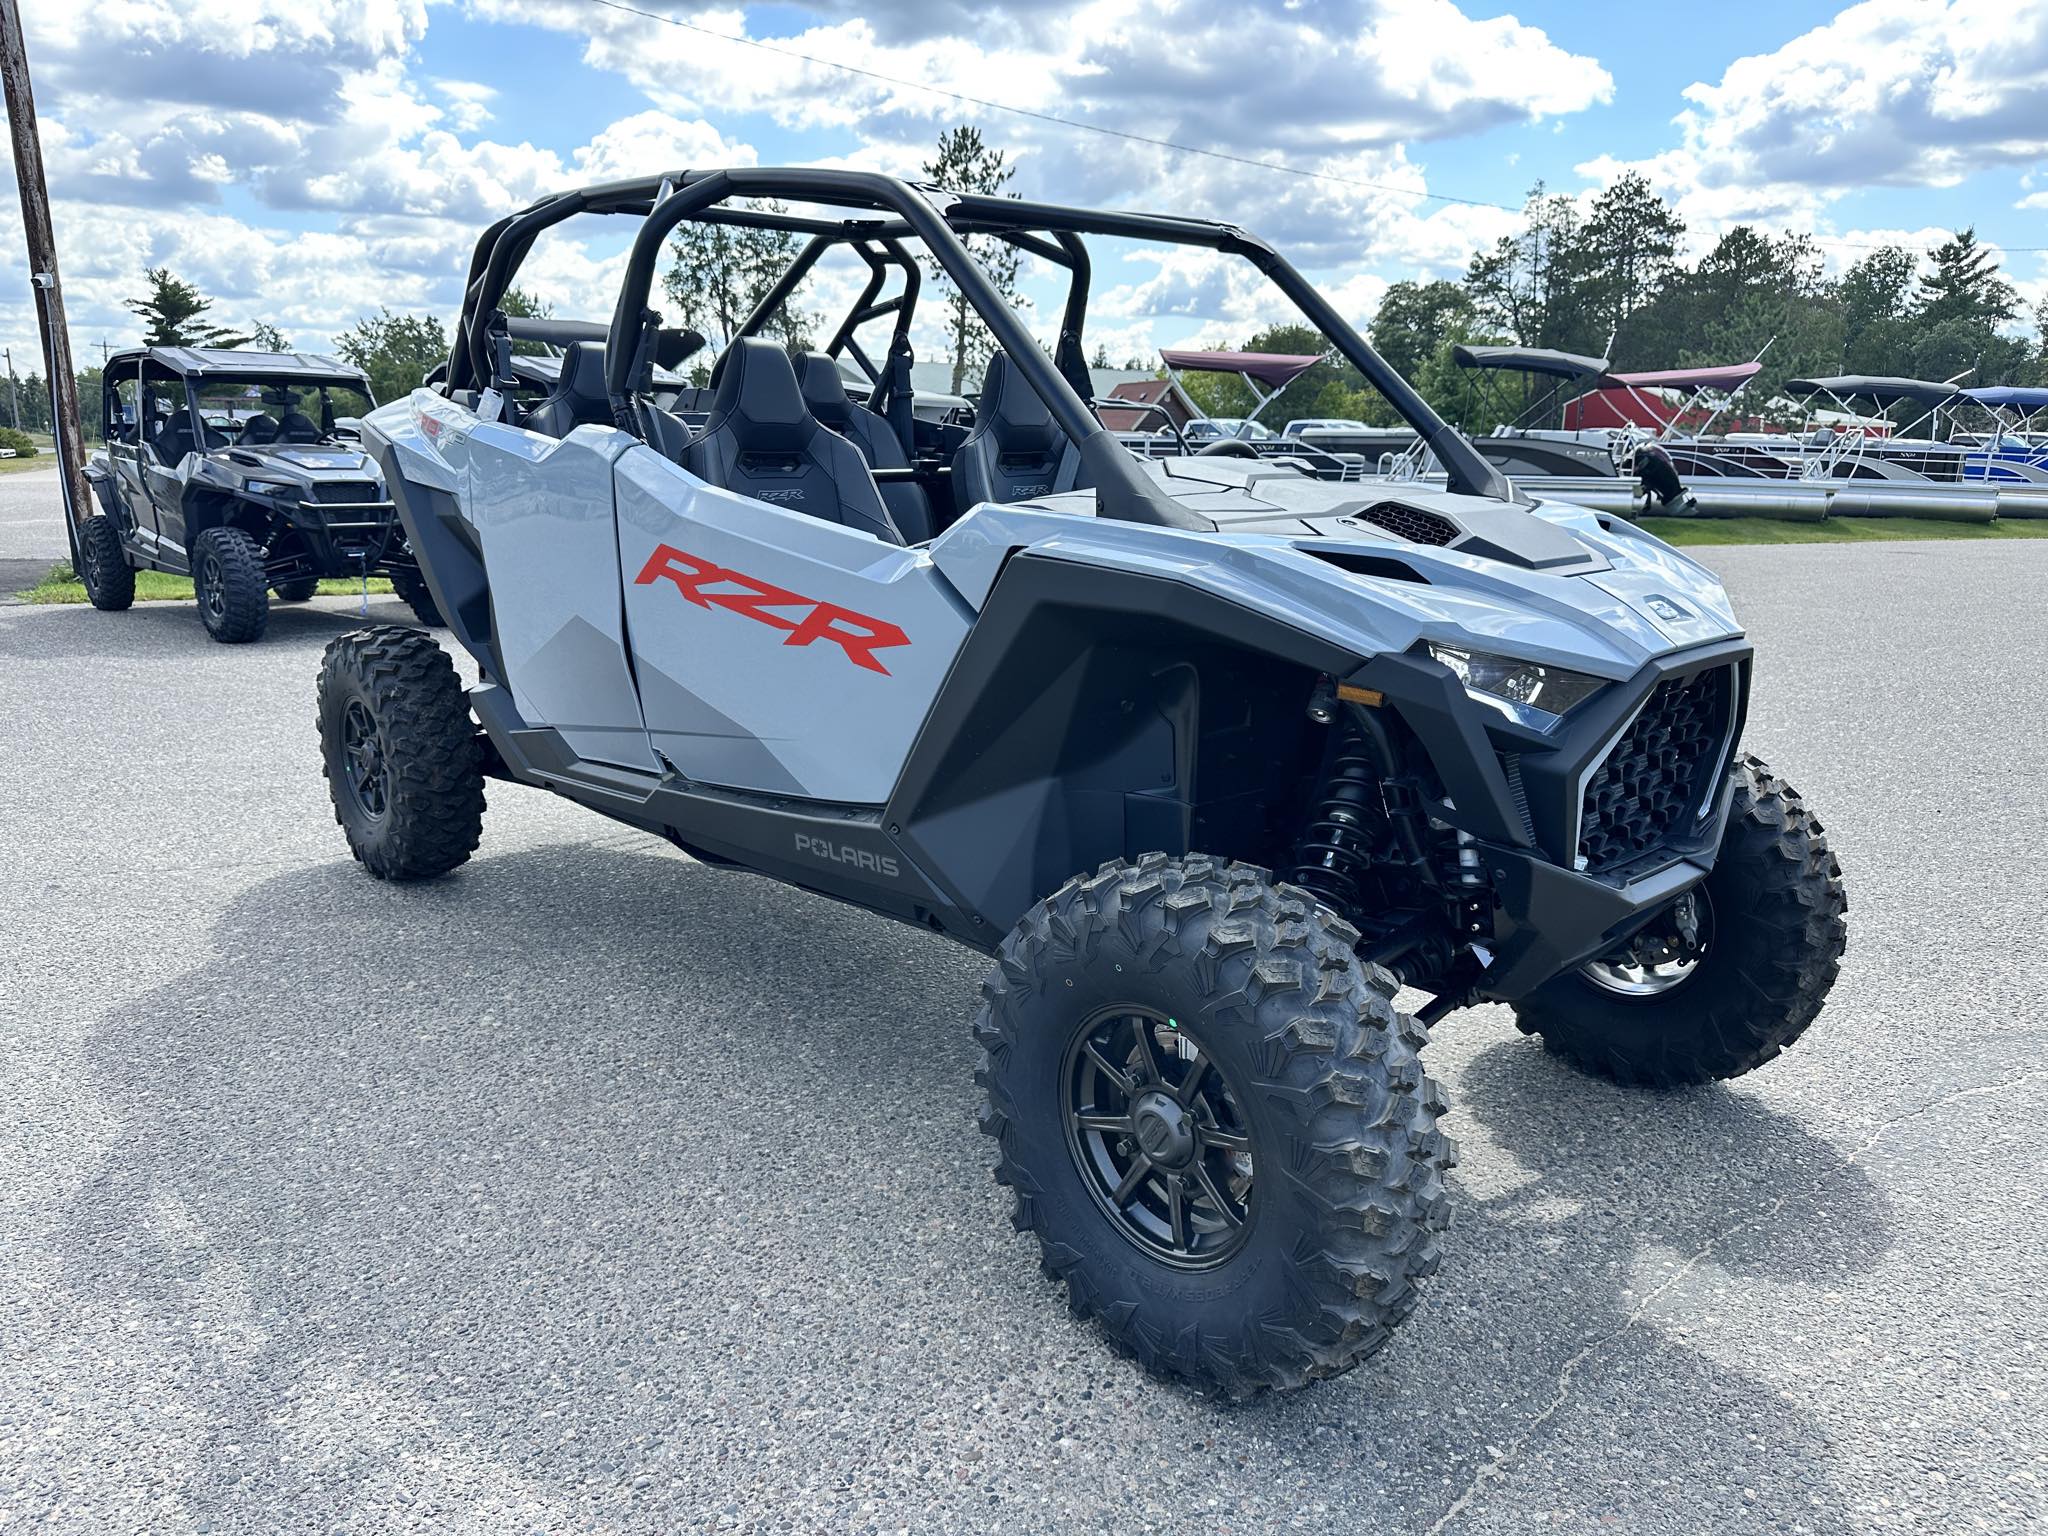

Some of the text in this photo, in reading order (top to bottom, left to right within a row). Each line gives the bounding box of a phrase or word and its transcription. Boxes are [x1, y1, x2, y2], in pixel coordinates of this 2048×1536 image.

[756, 489, 805, 501] RZR
[1012, 485, 1050, 496] RZR
[634, 543, 912, 677] RZR
[794, 832, 900, 878] POLARIS
